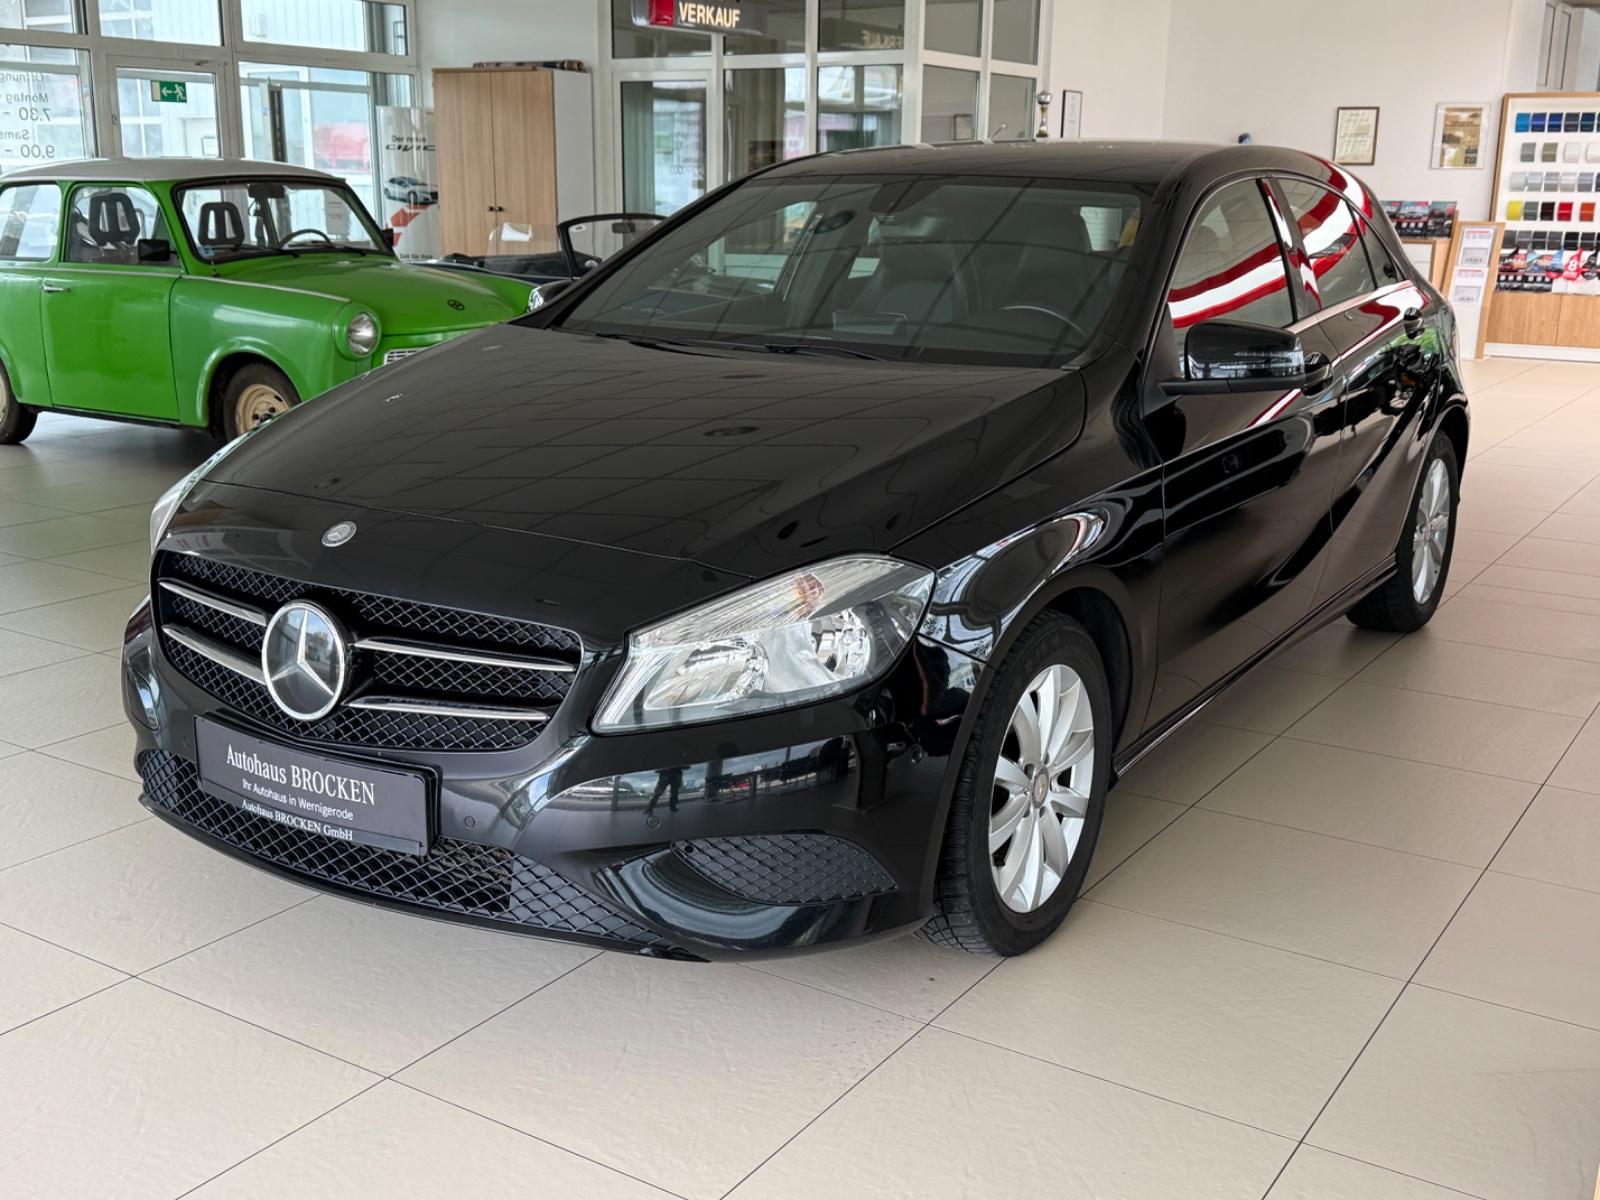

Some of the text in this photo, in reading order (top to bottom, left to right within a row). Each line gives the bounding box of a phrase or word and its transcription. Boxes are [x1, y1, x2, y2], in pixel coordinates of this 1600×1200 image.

[678, 1, 741, 28] VERKAUF
[226, 743, 375, 806] Autohaus BROCKEN
[241, 799, 353, 841] Autohaus BROCKEN GmbH
[242, 778, 354, 821] Ihr Autohaus in Wernigerode
